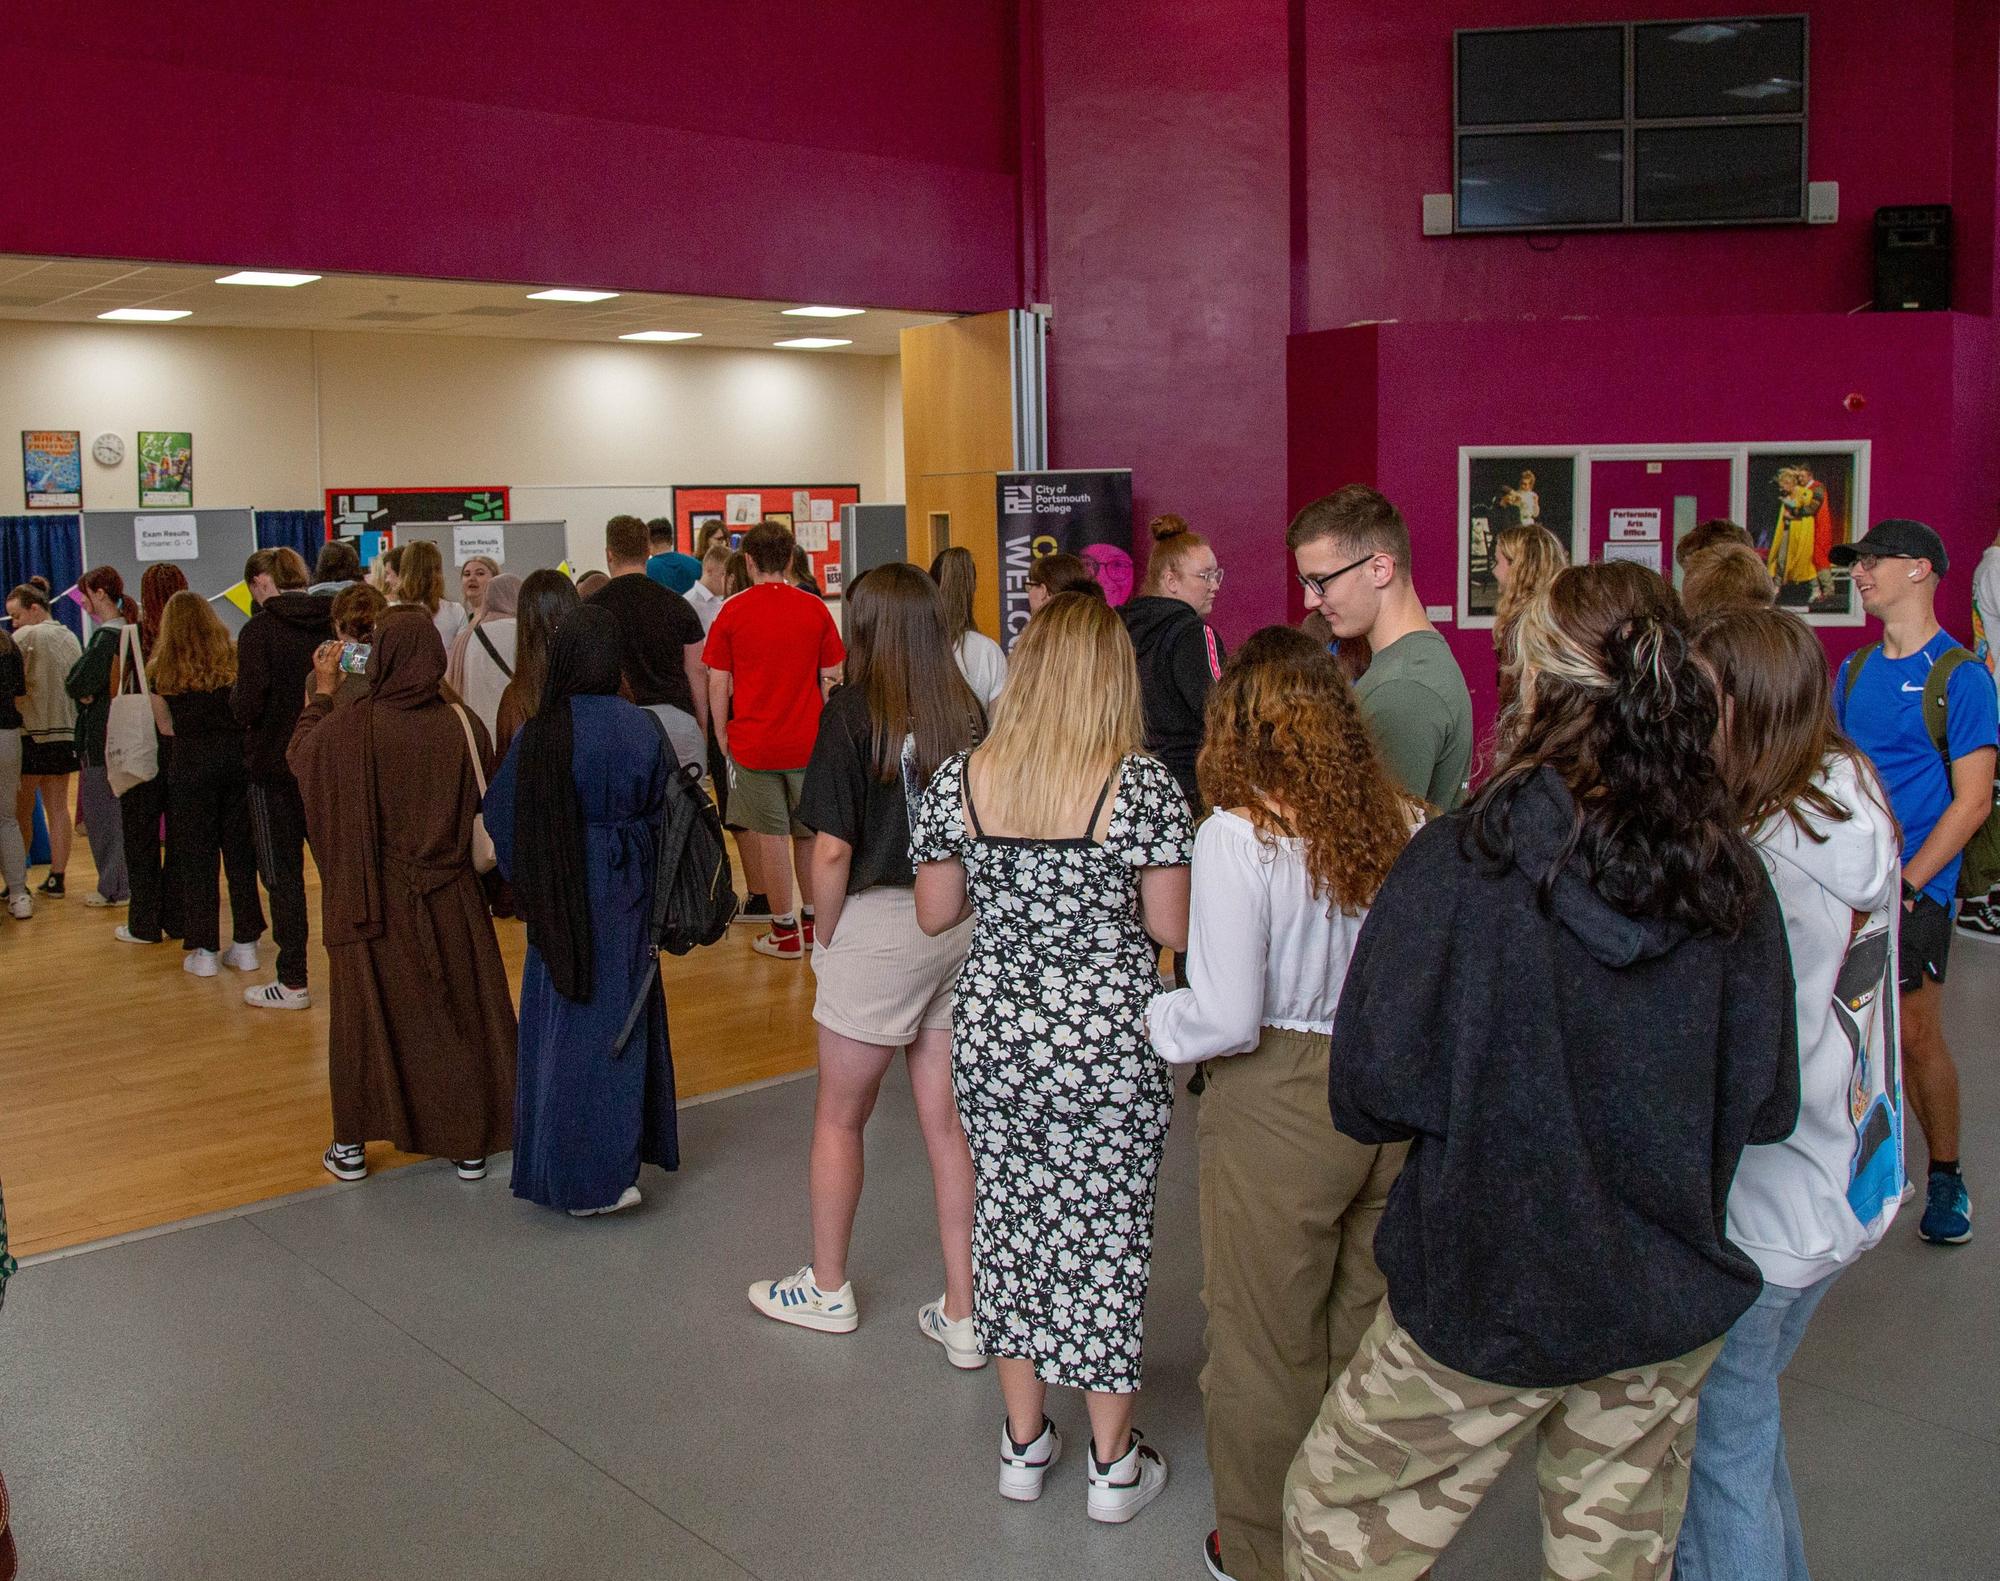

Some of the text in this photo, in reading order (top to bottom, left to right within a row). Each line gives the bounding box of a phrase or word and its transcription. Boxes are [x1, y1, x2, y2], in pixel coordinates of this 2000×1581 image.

[1035, 484, 1067, 496] City of
[1036, 493, 1091, 504] Portsmouth
[1035, 504, 1072, 515] College
[1613, 511, 1658, 519] Performing
[142, 530, 162, 538] Exam
[1623, 529, 1646, 537] Office
